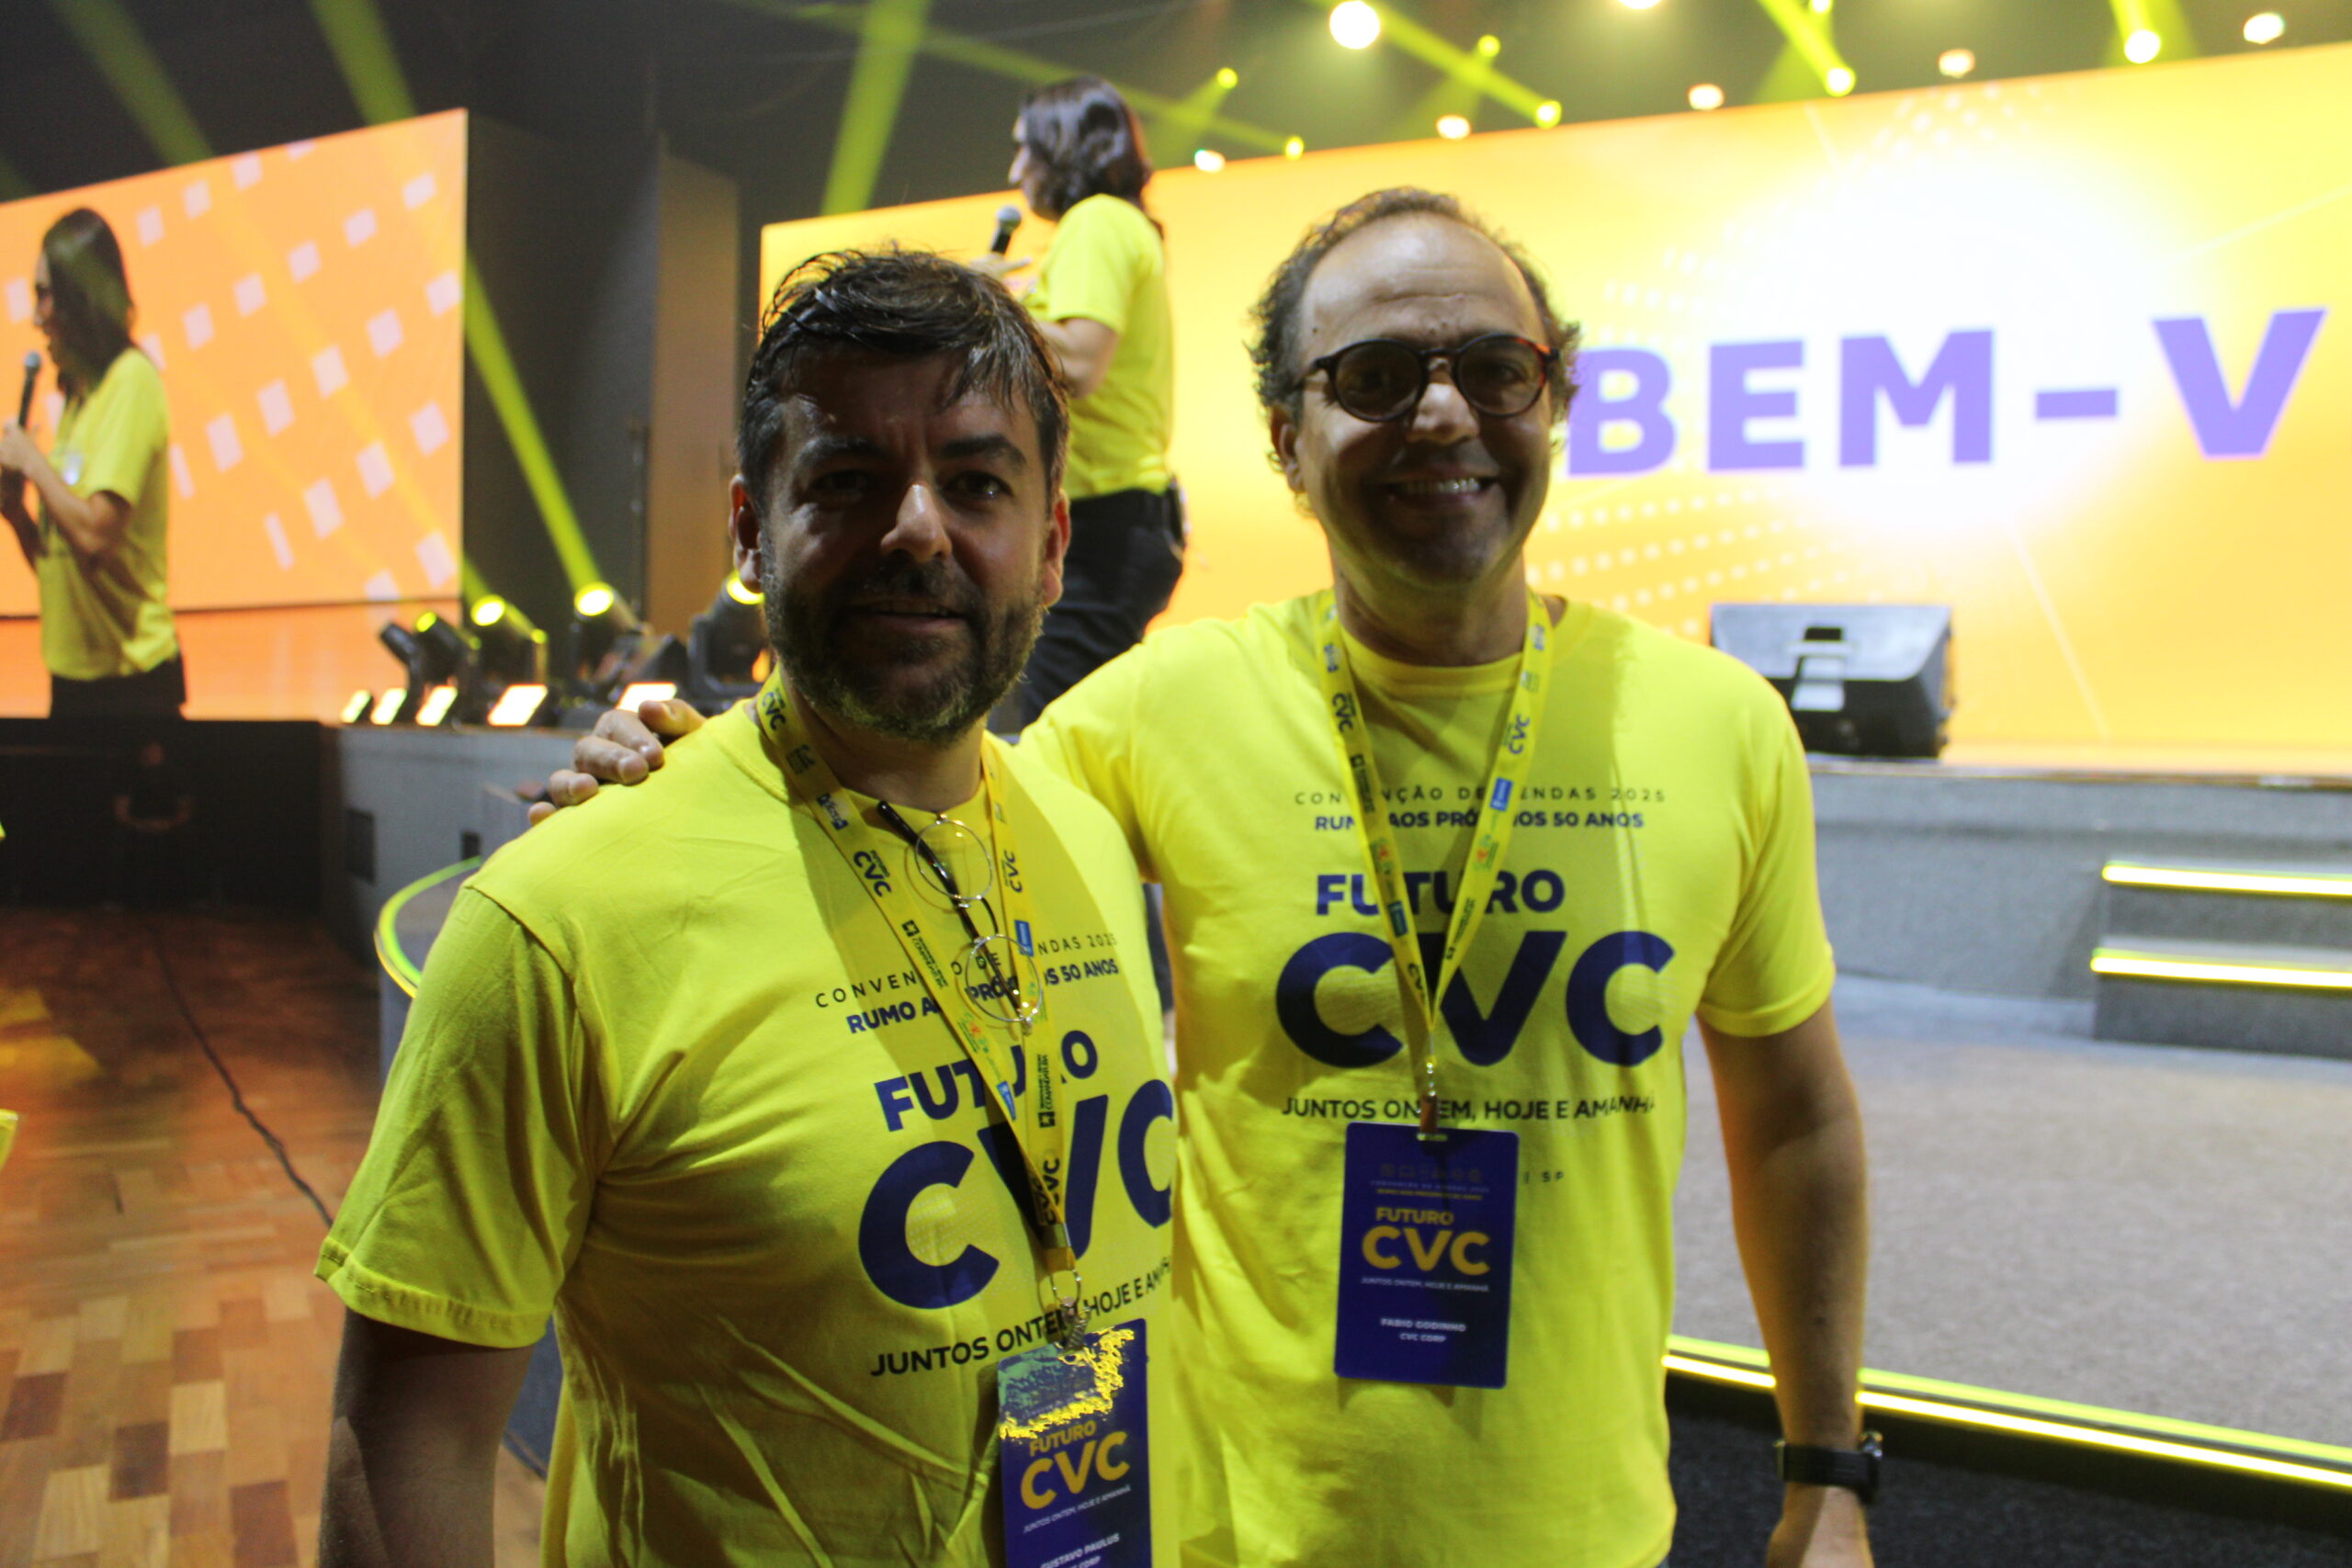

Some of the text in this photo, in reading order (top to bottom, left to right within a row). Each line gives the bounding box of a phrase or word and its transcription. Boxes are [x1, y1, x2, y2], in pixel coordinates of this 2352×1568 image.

[1332, 694, 1353, 733] CVC
[1508, 714, 1531, 755] CVC
[1295, 785, 1442, 805] CONNÇÃO
[1458, 787, 1485, 800] DE
[1520, 787, 1597, 801] ENDAS
[1611, 787, 1665, 802] 2025
[1389, 812, 1430, 828] AOS
[1554, 811, 1580, 828] 50
[1585, 811, 1645, 828] ANOS
[853, 851, 892, 898] CVC
[1003, 850, 1023, 893] CVC
[816, 961, 963, 1008] CONVENO
[1060, 964, 1082, 983] 50
[1086, 958, 1119, 978] ANOS
[846, 1000, 917, 1034] RUMO
[1276, 930, 1677, 1069] CVC
[1282, 1096, 1377, 1120] JUNTOS
[1384, 1100, 1476, 1122] ONEM,
[1485, 1100, 1550, 1121] HOJE
[1555, 1100, 1568, 1119] E
[1375, 1206, 1454, 1225] FUTURO
[1361, 1224, 1491, 1276] CVC
[870, 1337, 990, 1377] JUNTOS
[1083, 1283, 1132, 1317] HOJE
[1134, 1278, 1144, 1298] E
[1399, 1332, 1419, 1341] CVC
[1028, 1420, 1098, 1457] FUTURO
[1020, 1431, 1131, 1509] CVC
